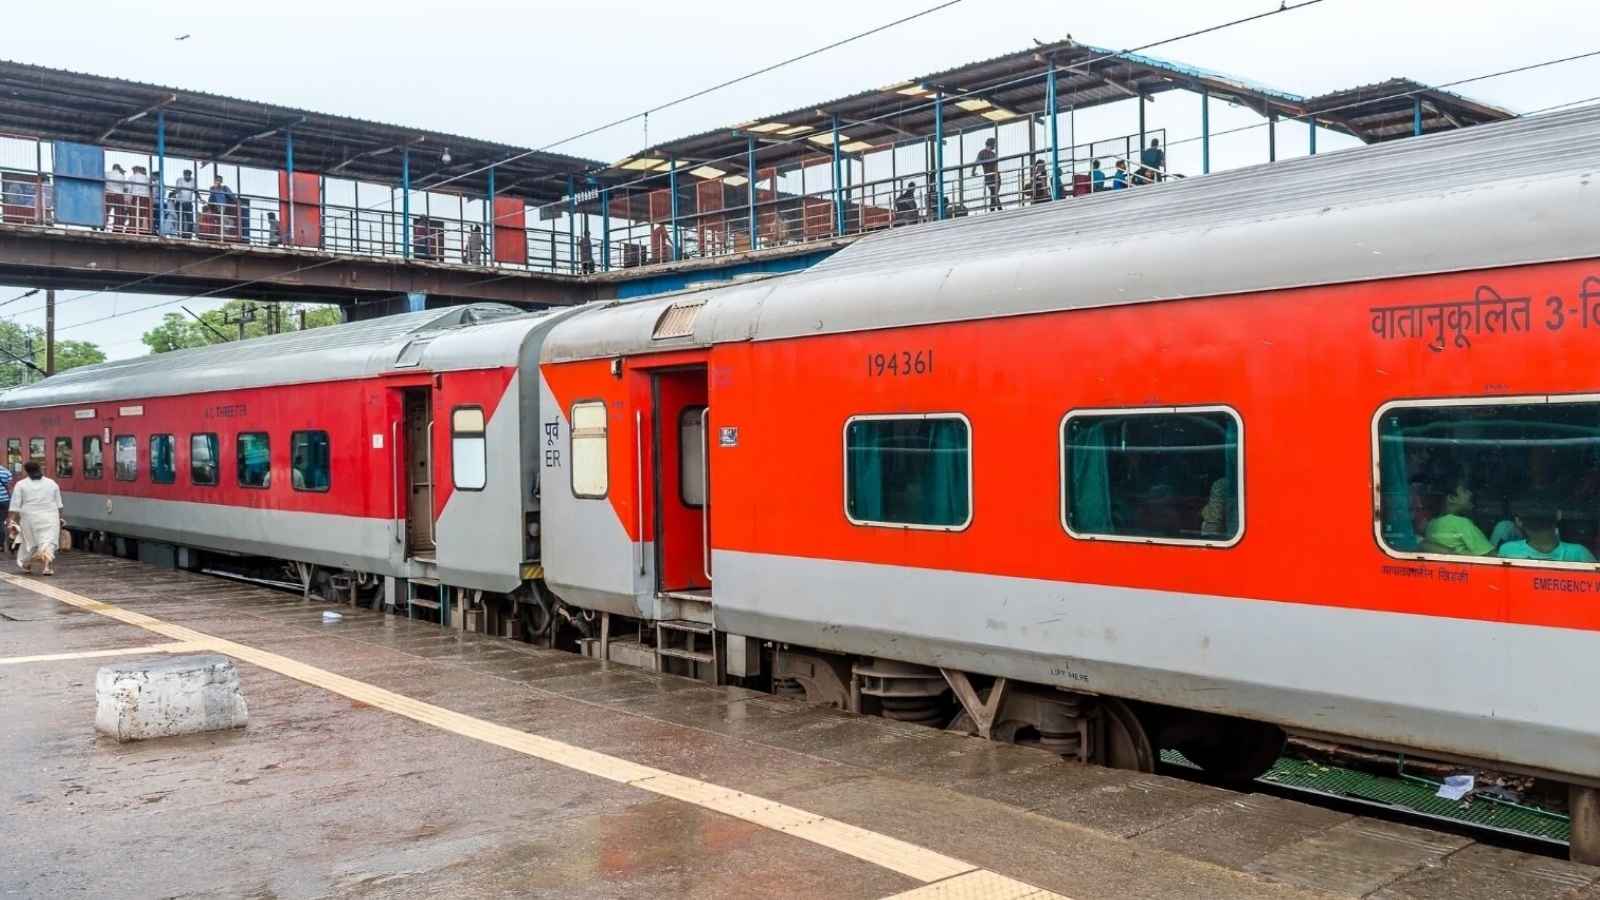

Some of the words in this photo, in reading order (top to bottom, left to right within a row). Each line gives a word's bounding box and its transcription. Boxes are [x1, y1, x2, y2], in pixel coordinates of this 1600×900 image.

[867, 349, 933, 377] 194361
[545, 416, 559, 446] पूर्व
[546, 450, 561, 468] ER
[1533, 576, 1593, 592] EMERGENCY
